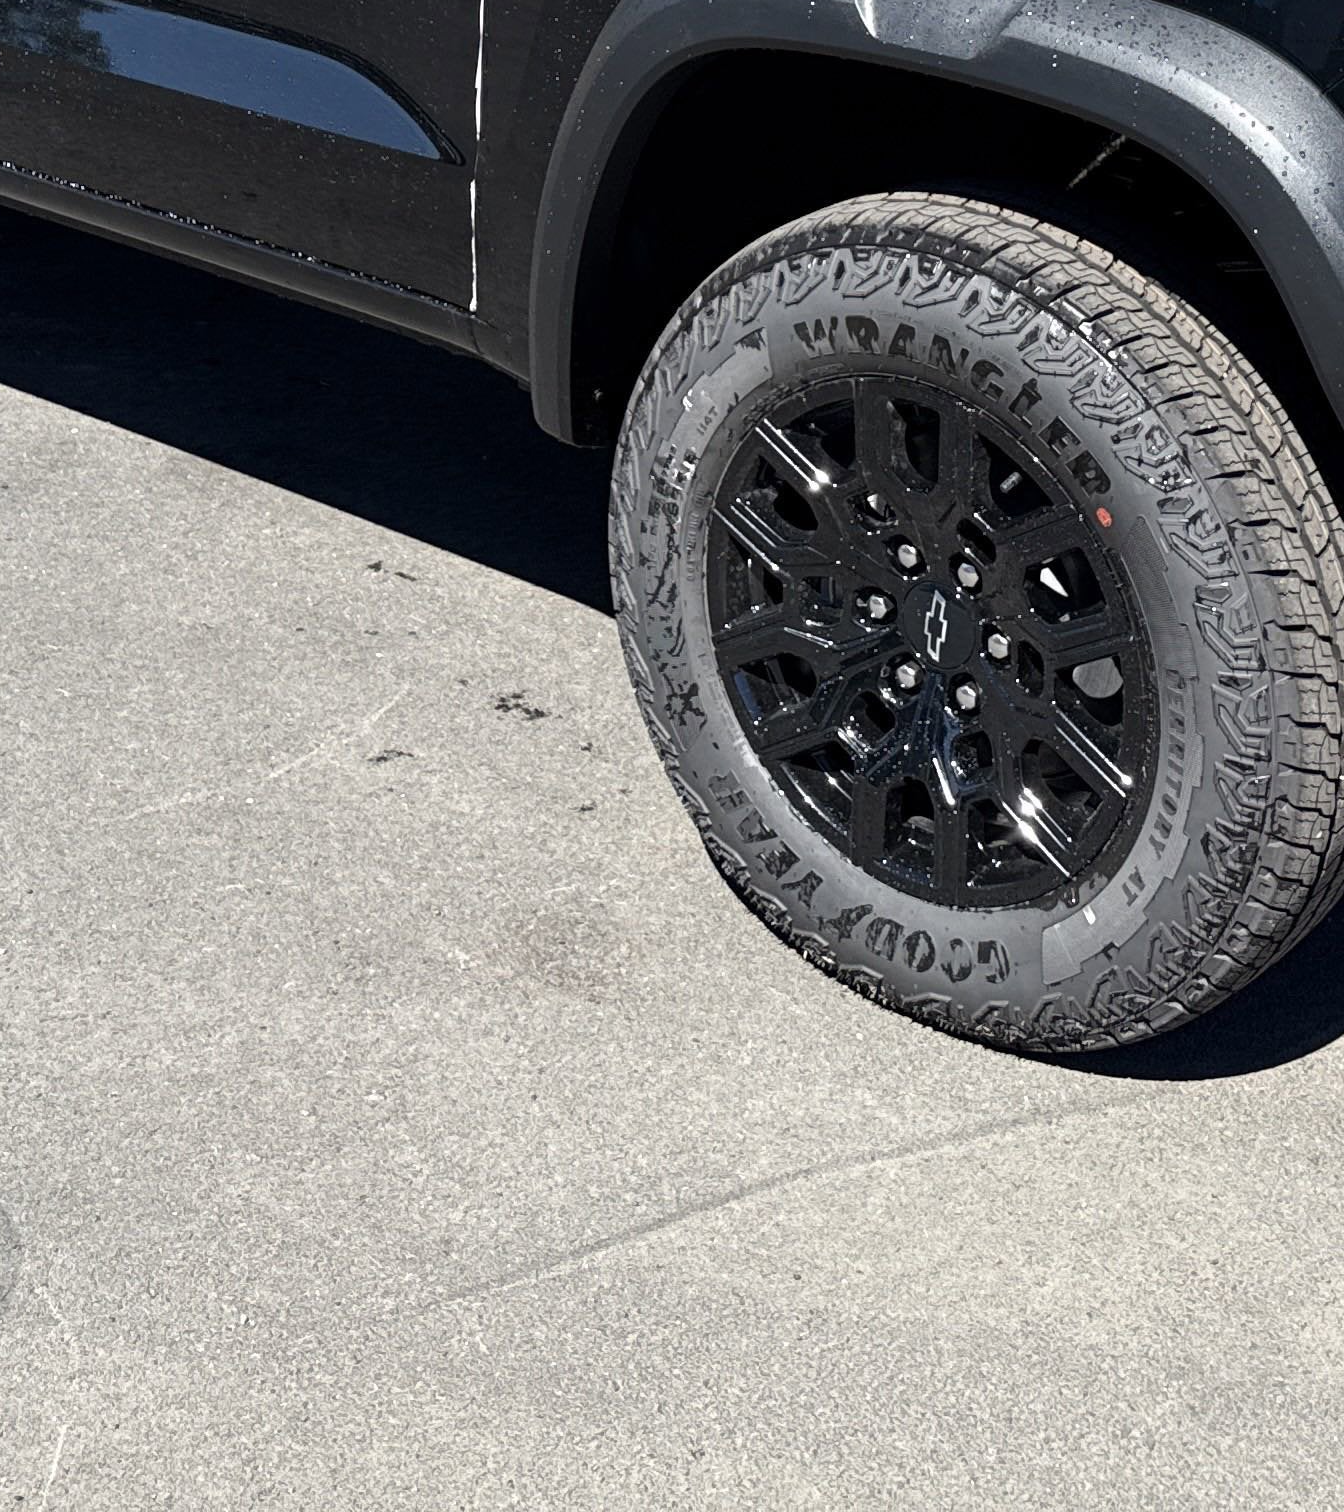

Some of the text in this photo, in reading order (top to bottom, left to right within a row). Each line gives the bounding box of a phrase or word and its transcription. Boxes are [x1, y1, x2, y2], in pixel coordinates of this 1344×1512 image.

[793, 314, 1111, 496] WRANGLER
[707, 768, 1011, 984] GOODYEAR
[1122, 669, 1186, 907] TERRITORY AT
